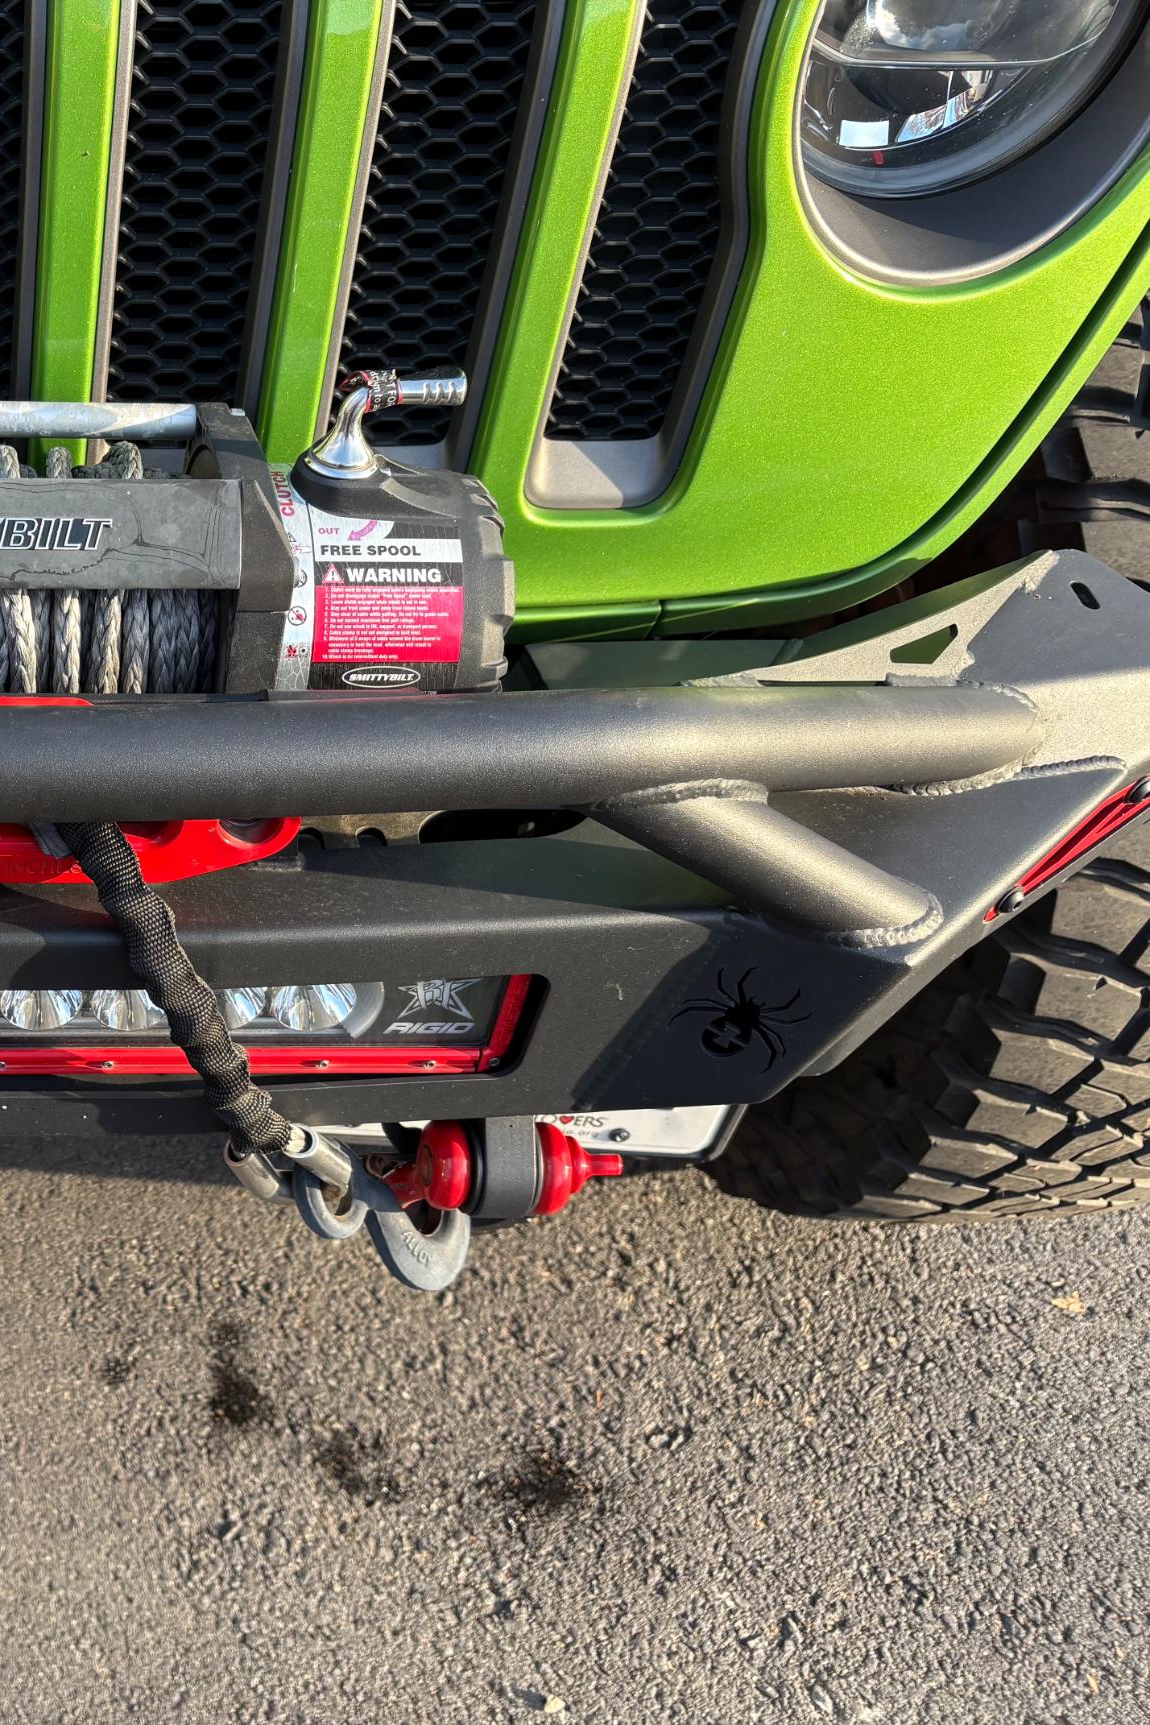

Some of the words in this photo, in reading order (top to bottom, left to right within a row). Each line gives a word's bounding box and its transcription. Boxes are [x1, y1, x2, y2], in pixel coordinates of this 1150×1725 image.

[273, 471, 295, 517] CLUTCH
[318, 527, 340, 535] OUT
[320, 545, 362, 556] FREE
[367, 545, 421, 556] SPOOL
[346, 568, 442, 584] WARNING
[348, 673, 414, 682] SMITTYBILT
[382, 1022, 476, 1034] RIGID
[402, 1230, 433, 1268] ALLOY
